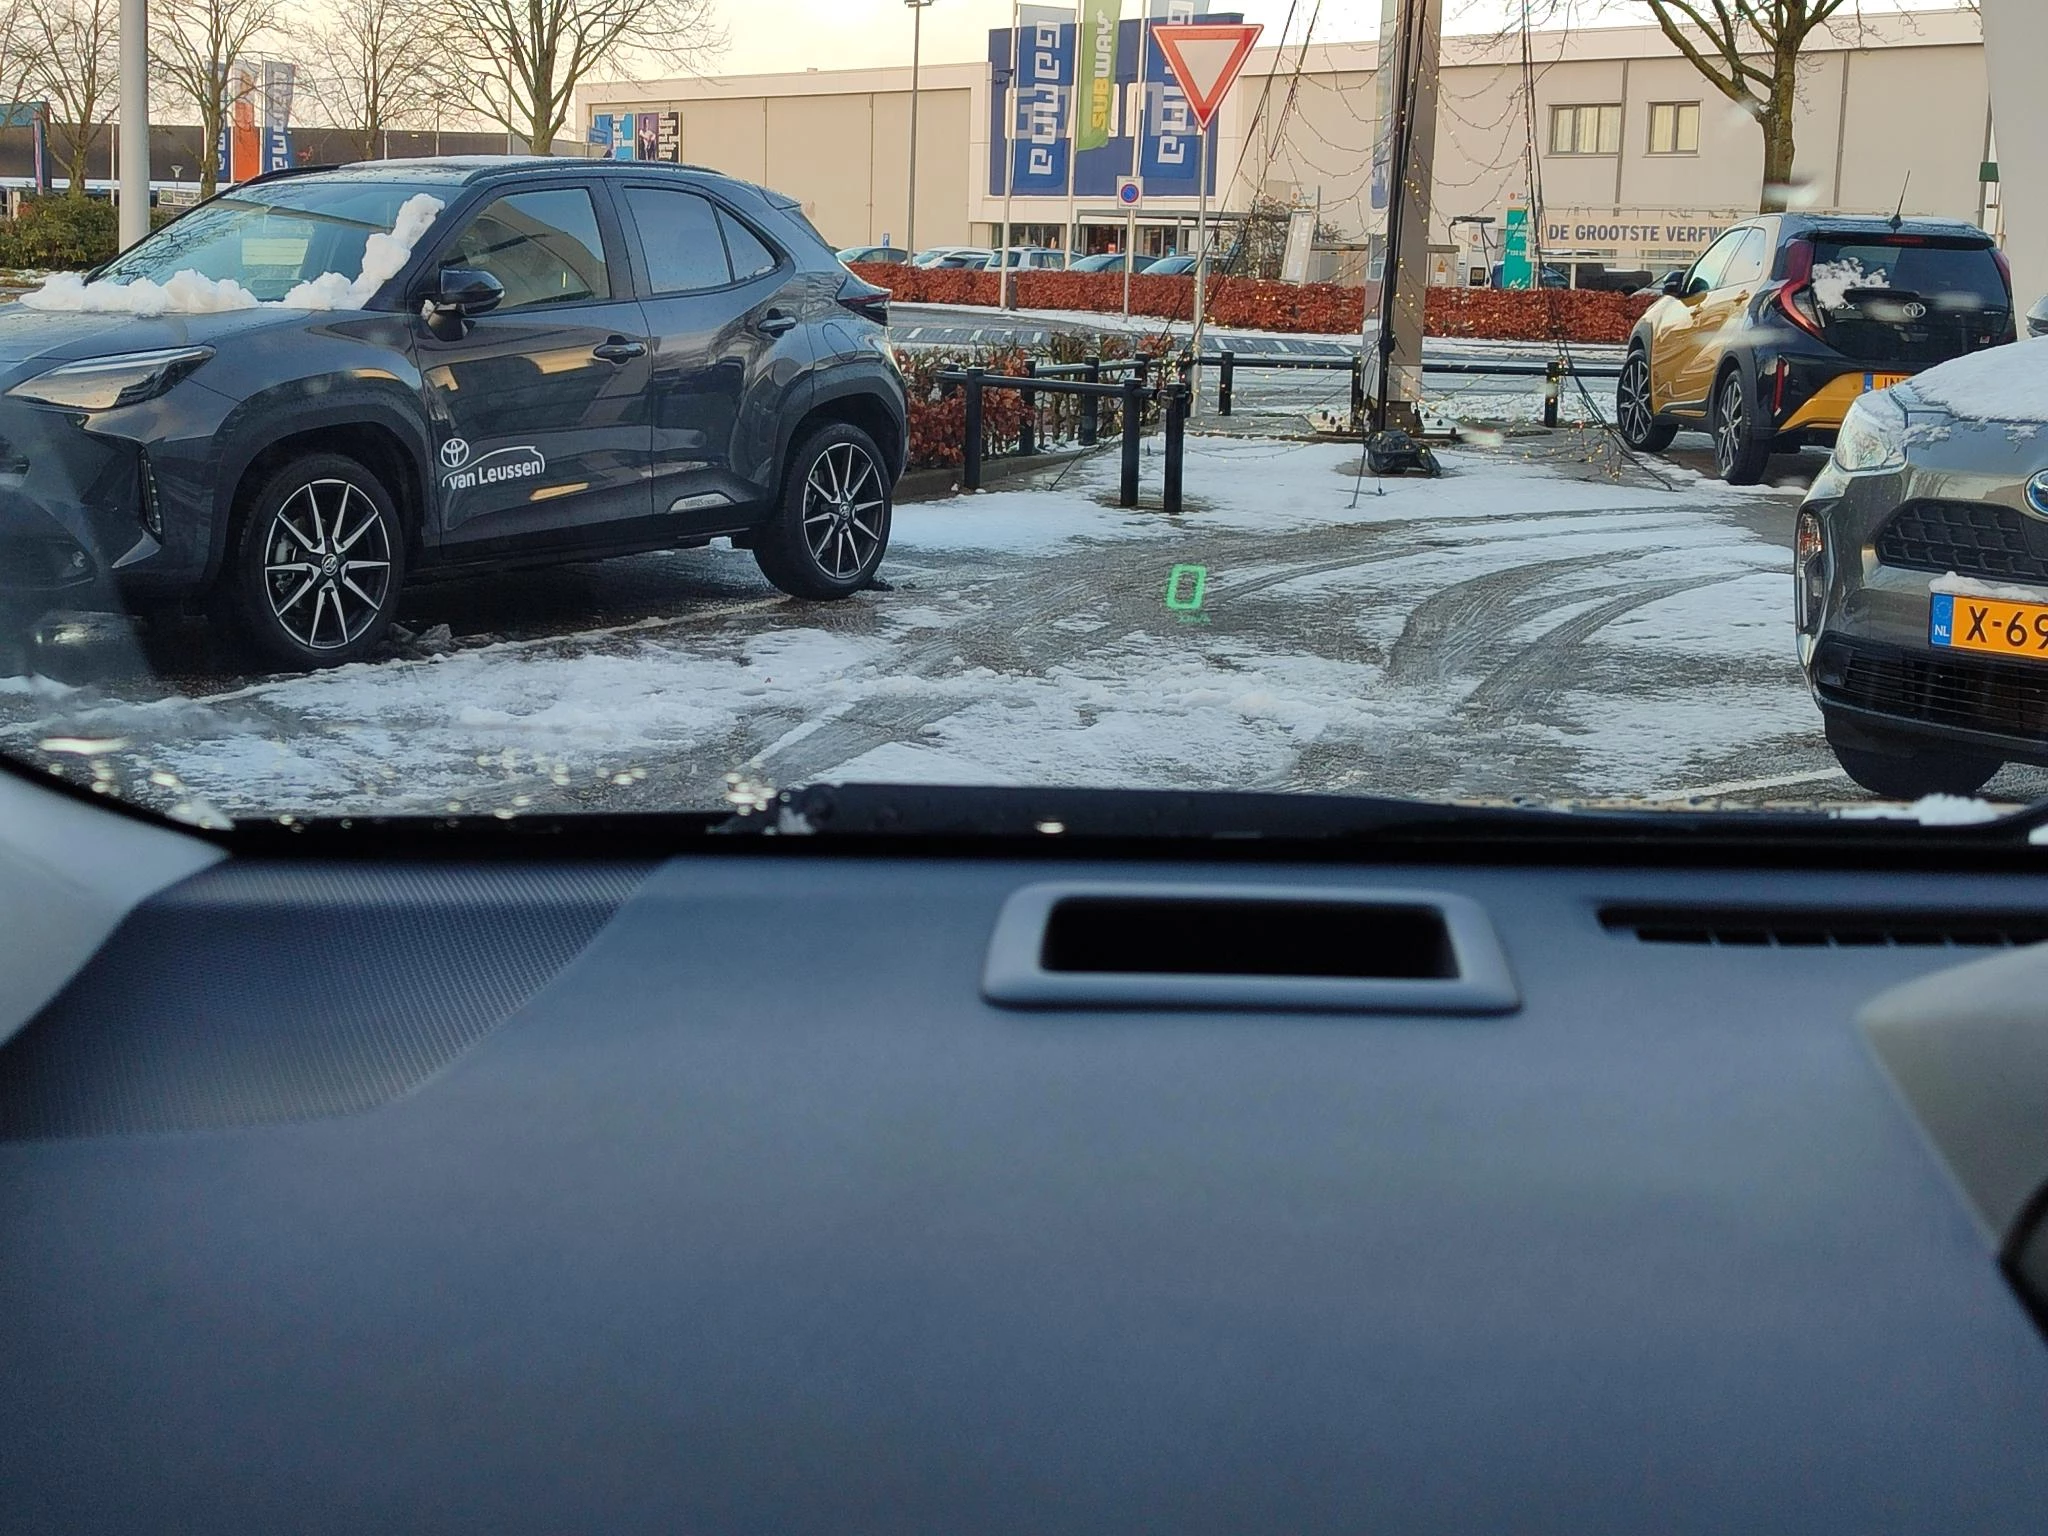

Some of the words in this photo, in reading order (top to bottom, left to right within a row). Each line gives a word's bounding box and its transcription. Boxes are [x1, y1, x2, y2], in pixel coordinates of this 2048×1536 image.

[1090, 9, 1114, 131] SUBWAY
[1549, 224, 1570, 241] DE
[1575, 224, 1660, 242] GROOTSTE
[1666, 225, 1728, 243] VERFW
[449, 471, 476, 490] van
[478, 460, 541, 486] Leussen
[1934, 623, 1950, 638] NL
